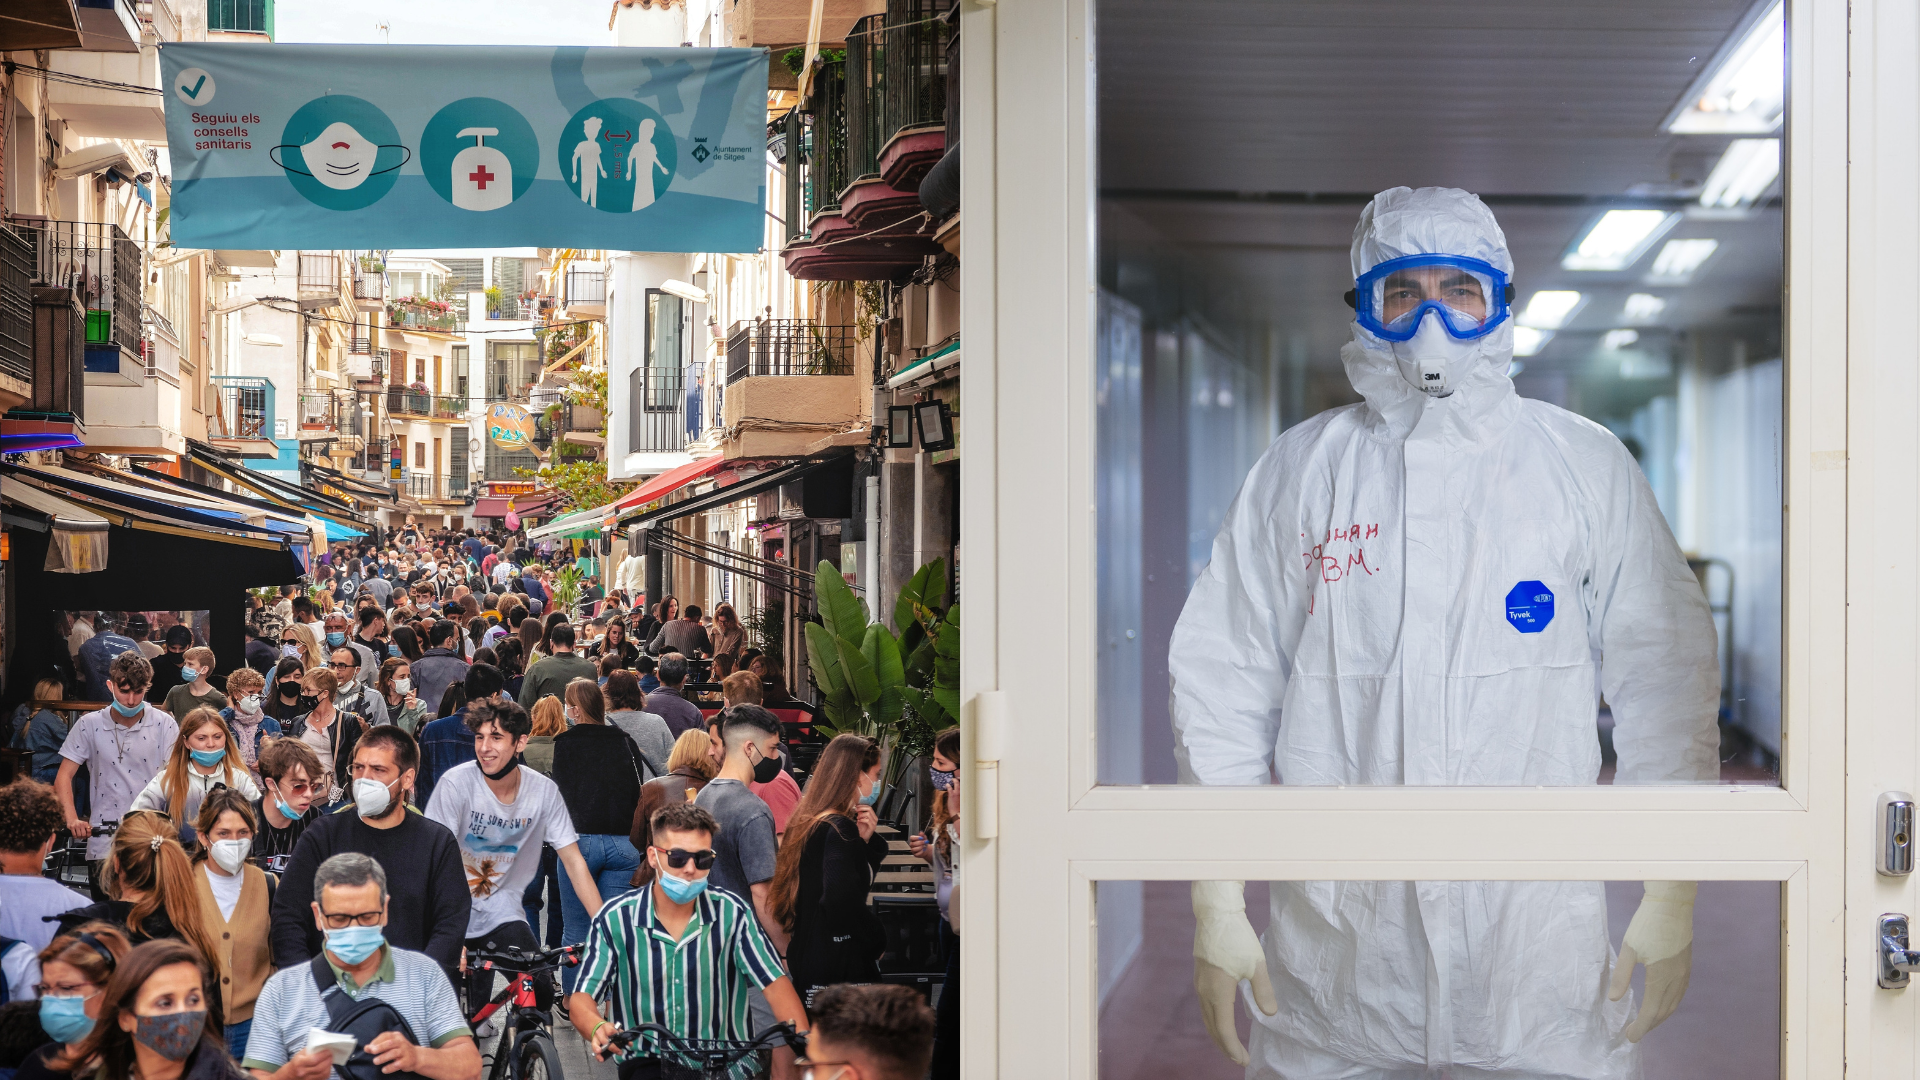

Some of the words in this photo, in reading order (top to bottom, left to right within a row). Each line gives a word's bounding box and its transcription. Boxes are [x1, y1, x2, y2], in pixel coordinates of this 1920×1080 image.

[192, 112, 237, 126] Seguiu
[241, 113, 260, 123] els
[194, 126, 248, 137] consells
[195, 139, 252, 150] sanitaris
[613, 143, 623, 158] 1,5
[713, 146, 752, 154] Ajuntament
[723, 154, 745, 162] Sitges
[614, 161, 622, 179] mts
[1424, 372, 1440, 381] 3M
[493, 405, 529, 421] PAY
[491, 426, 523, 440] PAY
[1509, 611, 1531, 620] Tyvek
[471, 811, 485, 824] THE
[487, 814, 508, 829] SURF
